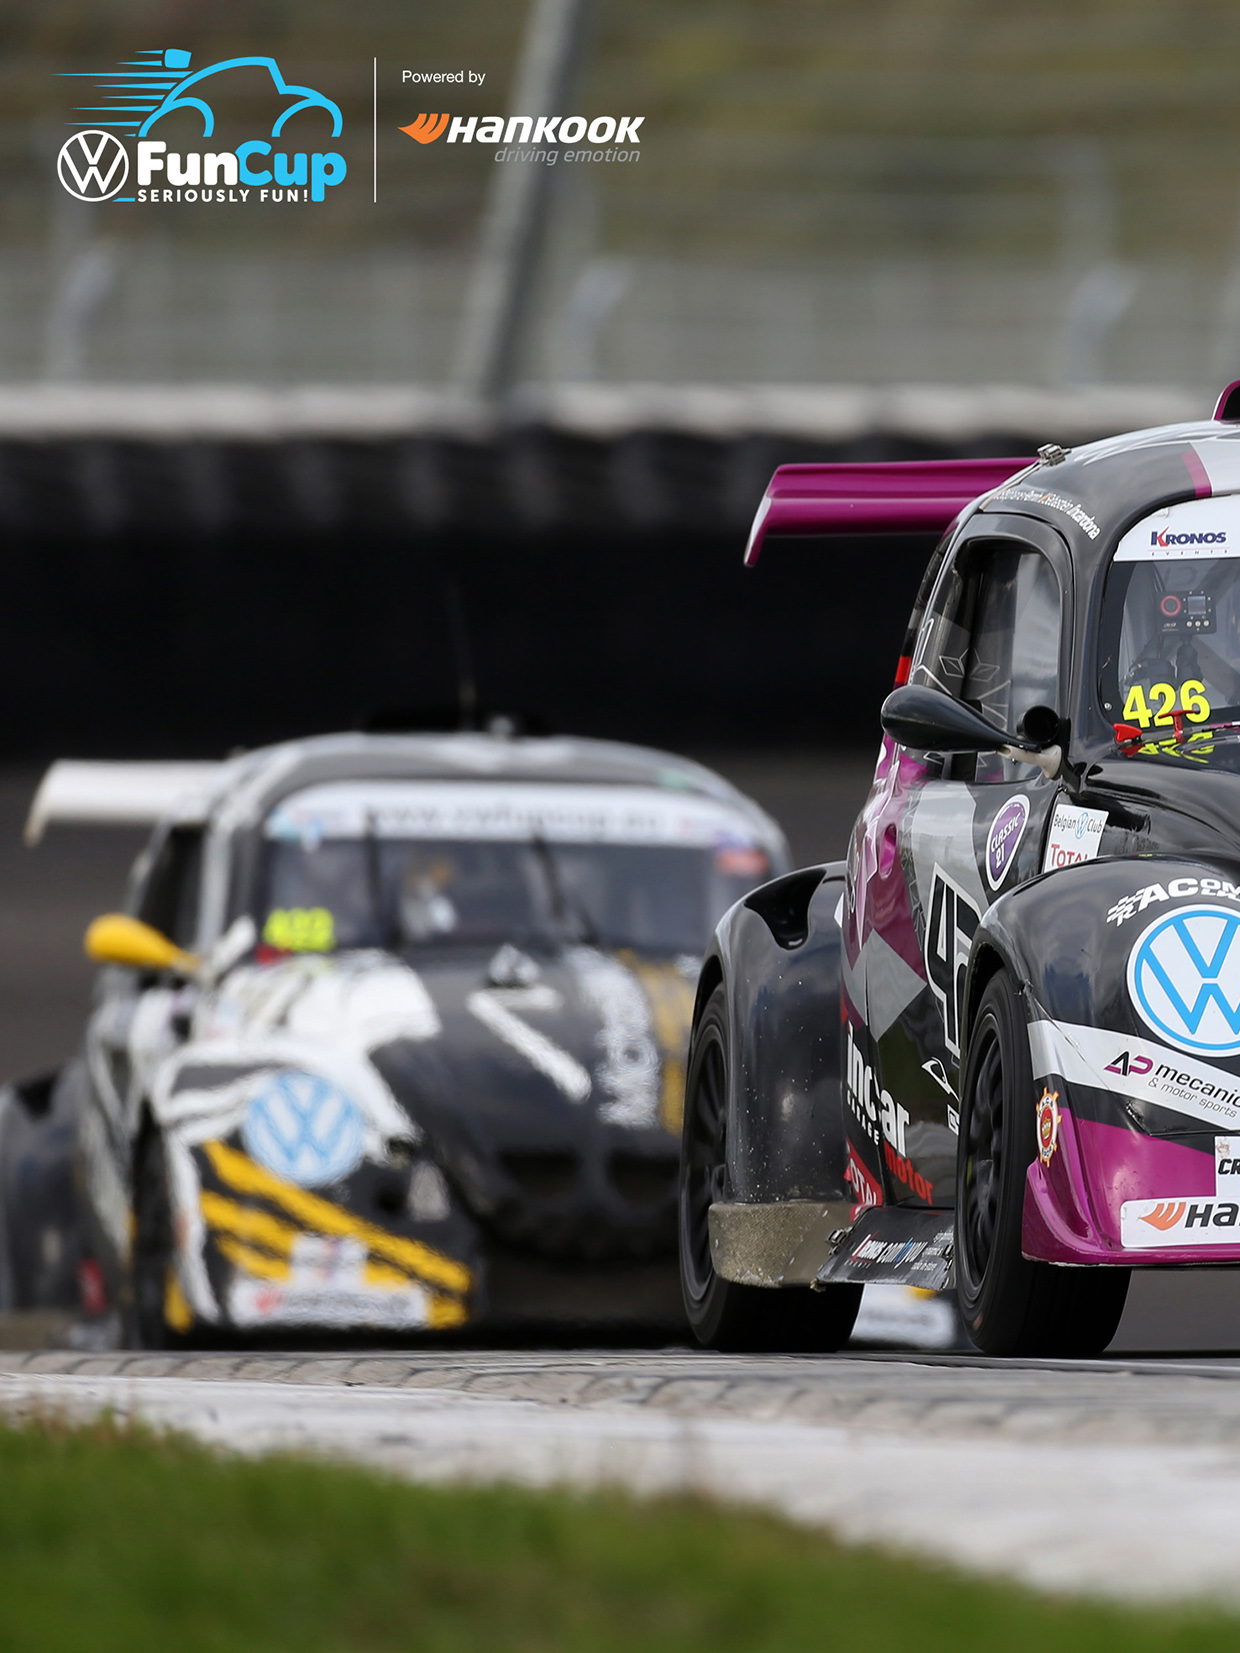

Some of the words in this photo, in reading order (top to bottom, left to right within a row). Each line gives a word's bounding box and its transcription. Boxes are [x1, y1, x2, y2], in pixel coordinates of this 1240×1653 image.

[1151, 526, 1227, 547] KRONOS
[1123, 680, 1211, 728] 426
[1053, 814, 1076, 832] Belgian
[1087, 818, 1102, 833] Club
[1051, 844, 1078, 868] TOTA
[1104, 1051, 1153, 1076] AP
[1148, 1078, 1158, 1088] &
[1161, 1083, 1198, 1101] motor
[1199, 1097, 1238, 1118] sports
[884, 1140, 934, 1206] motor
